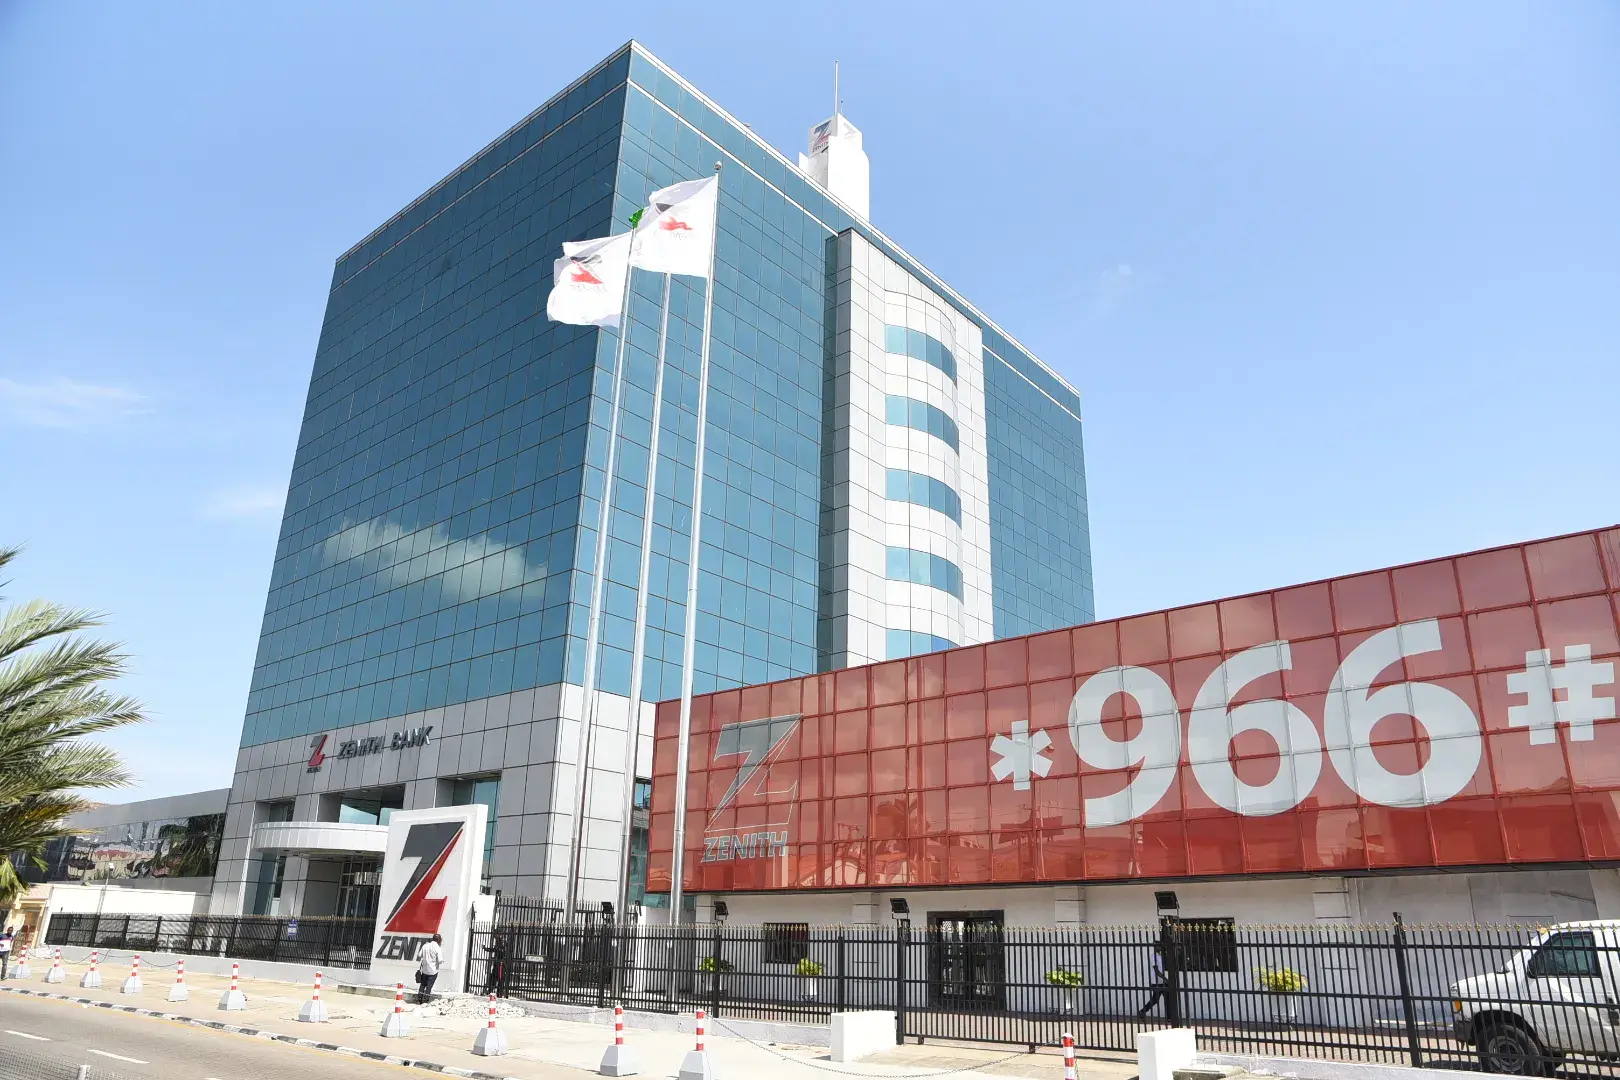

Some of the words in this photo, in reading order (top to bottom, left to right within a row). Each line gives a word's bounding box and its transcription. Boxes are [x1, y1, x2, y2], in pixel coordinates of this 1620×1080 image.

[337, 735, 385, 759] ZENITH
[390, 725, 434, 751] BANK
[700, 831, 788, 863] ZENITH
[375, 935, 433, 962] ZENIT
